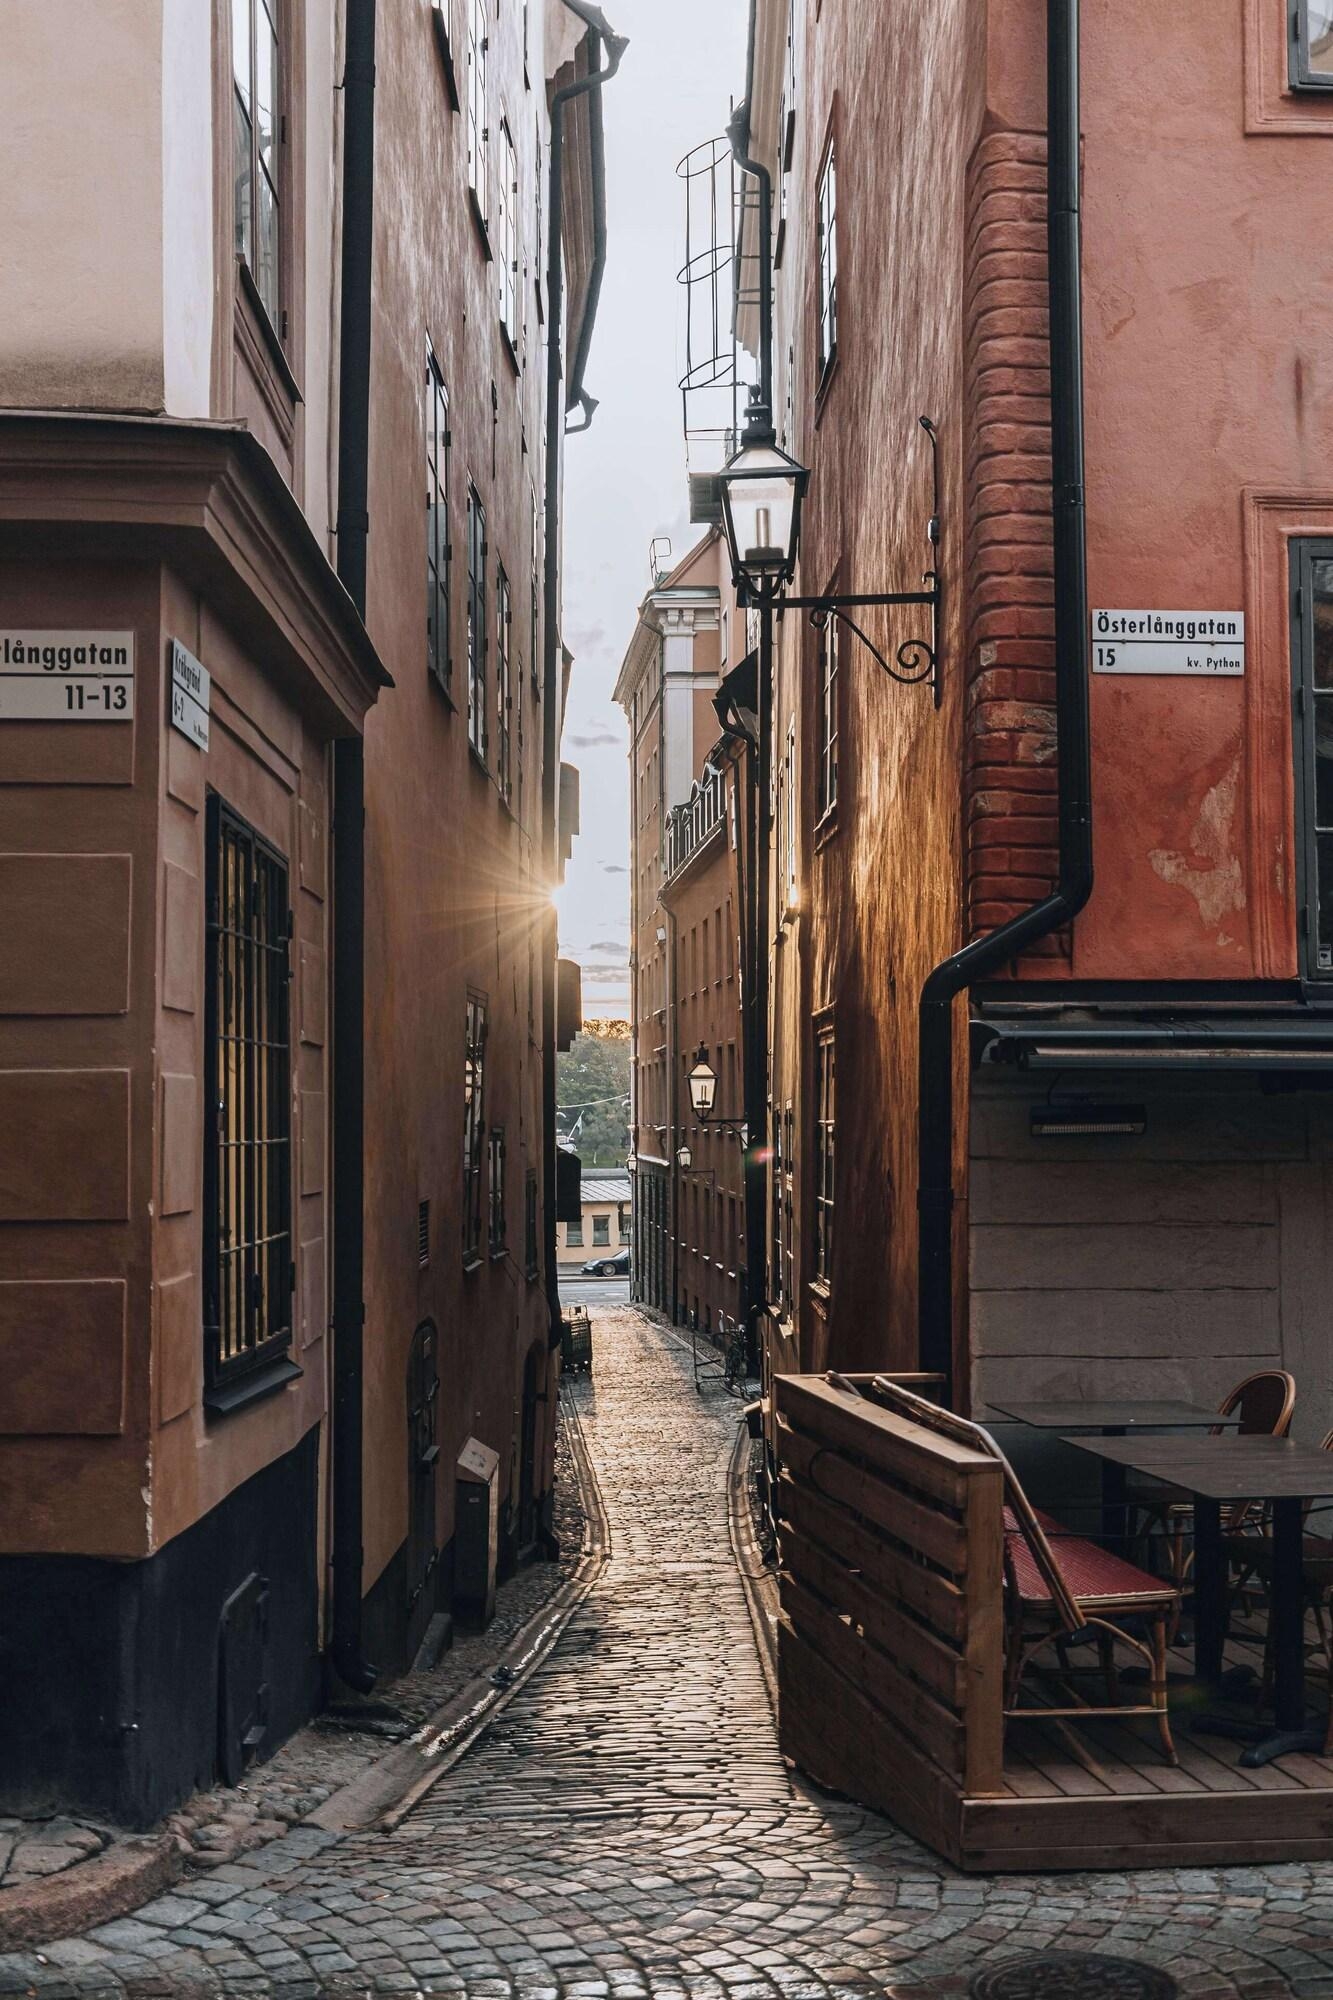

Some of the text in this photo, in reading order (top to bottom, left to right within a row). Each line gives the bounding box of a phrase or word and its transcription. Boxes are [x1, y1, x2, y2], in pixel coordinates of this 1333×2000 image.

[1097, 612, 1236, 639] Österlånggatan
[0, 638, 127, 671] långgatan
[1097, 648, 1240, 671] 15 kv. Python
[65, 684, 127, 710] 11-13
